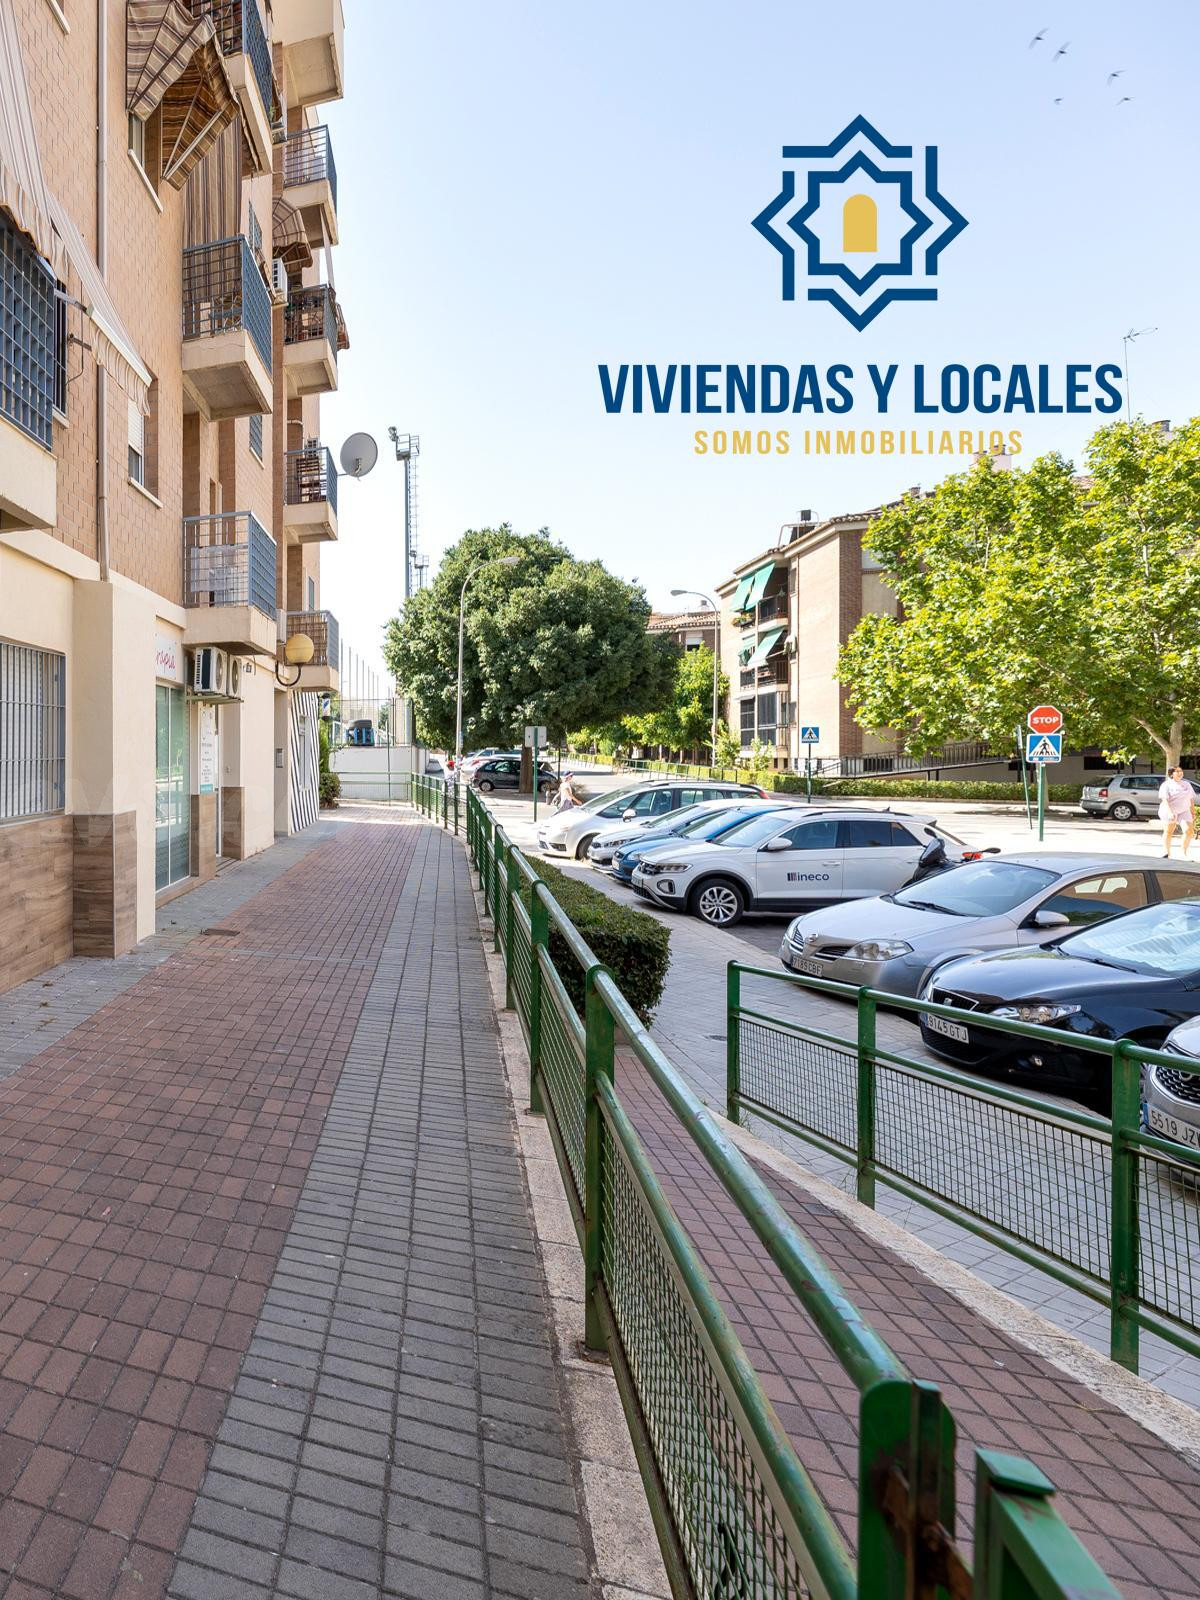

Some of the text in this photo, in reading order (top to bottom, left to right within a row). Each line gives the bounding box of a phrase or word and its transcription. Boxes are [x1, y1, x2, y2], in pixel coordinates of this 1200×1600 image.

[1032, 716, 1059, 724] STOP
[797, 871, 830, 881] ineco
[928, 1015, 968, 1041] 9145 GTJ
[1151, 1109, 1178, 1136] 5519
